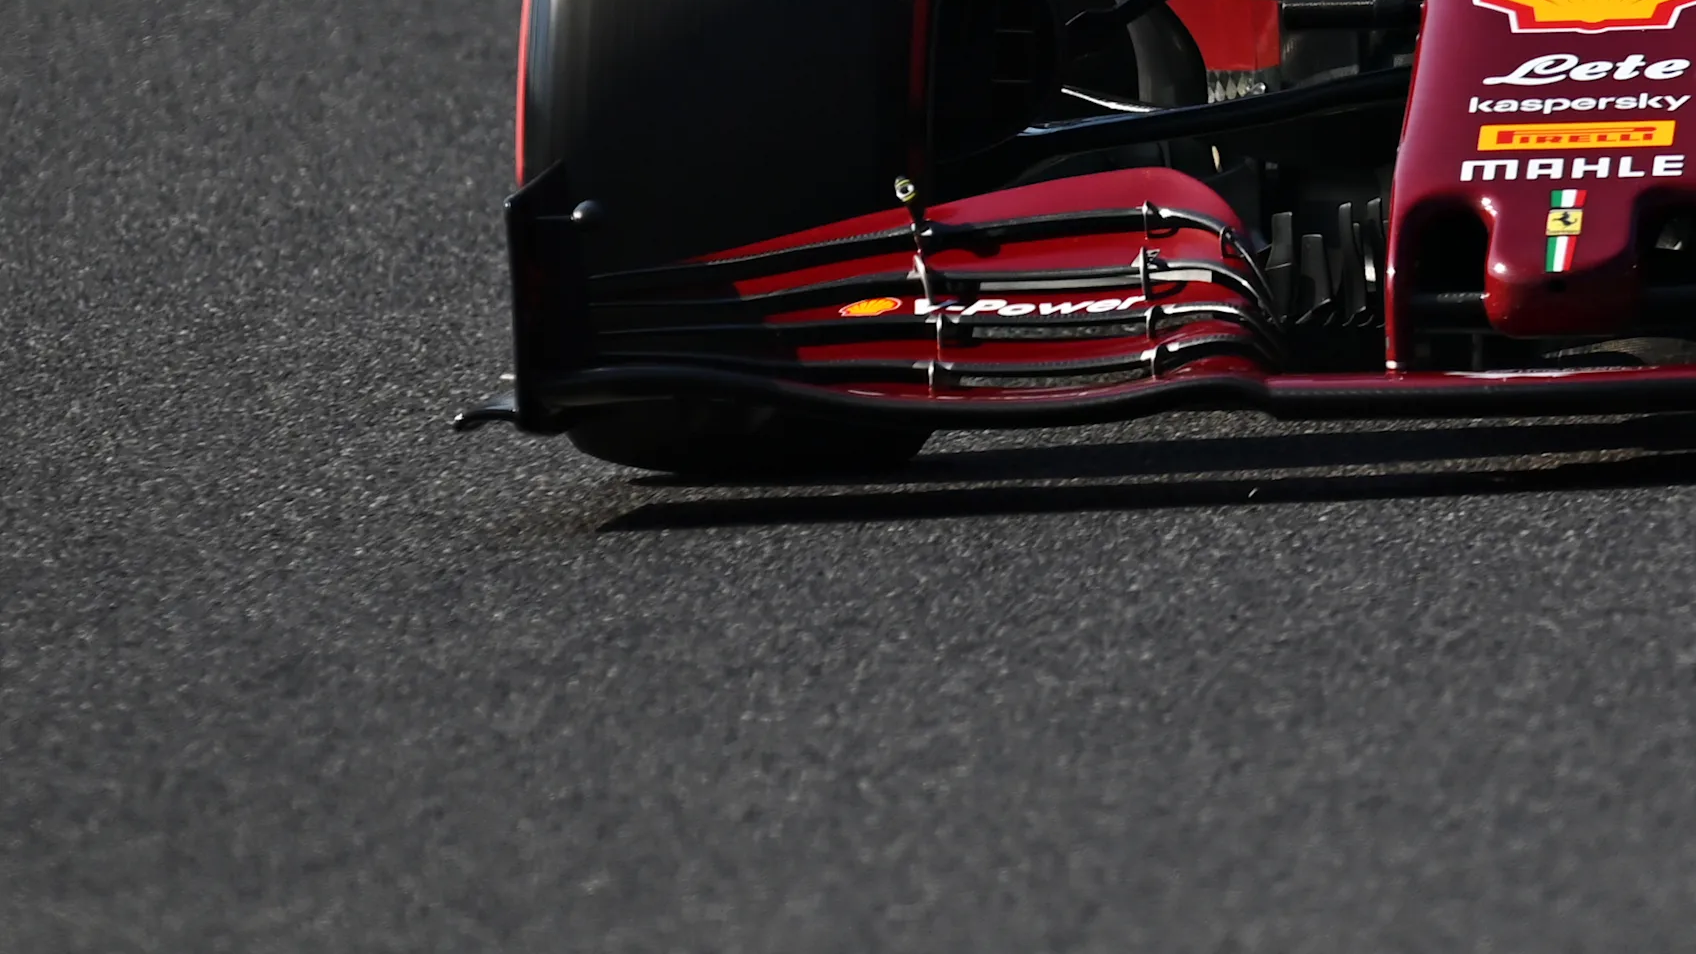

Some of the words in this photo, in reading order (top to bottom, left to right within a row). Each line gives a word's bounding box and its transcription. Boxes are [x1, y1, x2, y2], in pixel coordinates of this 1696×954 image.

[1482, 53, 1690, 86] Lete
[1468, 93, 1691, 114] kaspersky
[1495, 126, 1657, 145] PIRELLI
[1459, 154, 1685, 182] MAHLE
[914, 295, 1146, 316] V-Power
